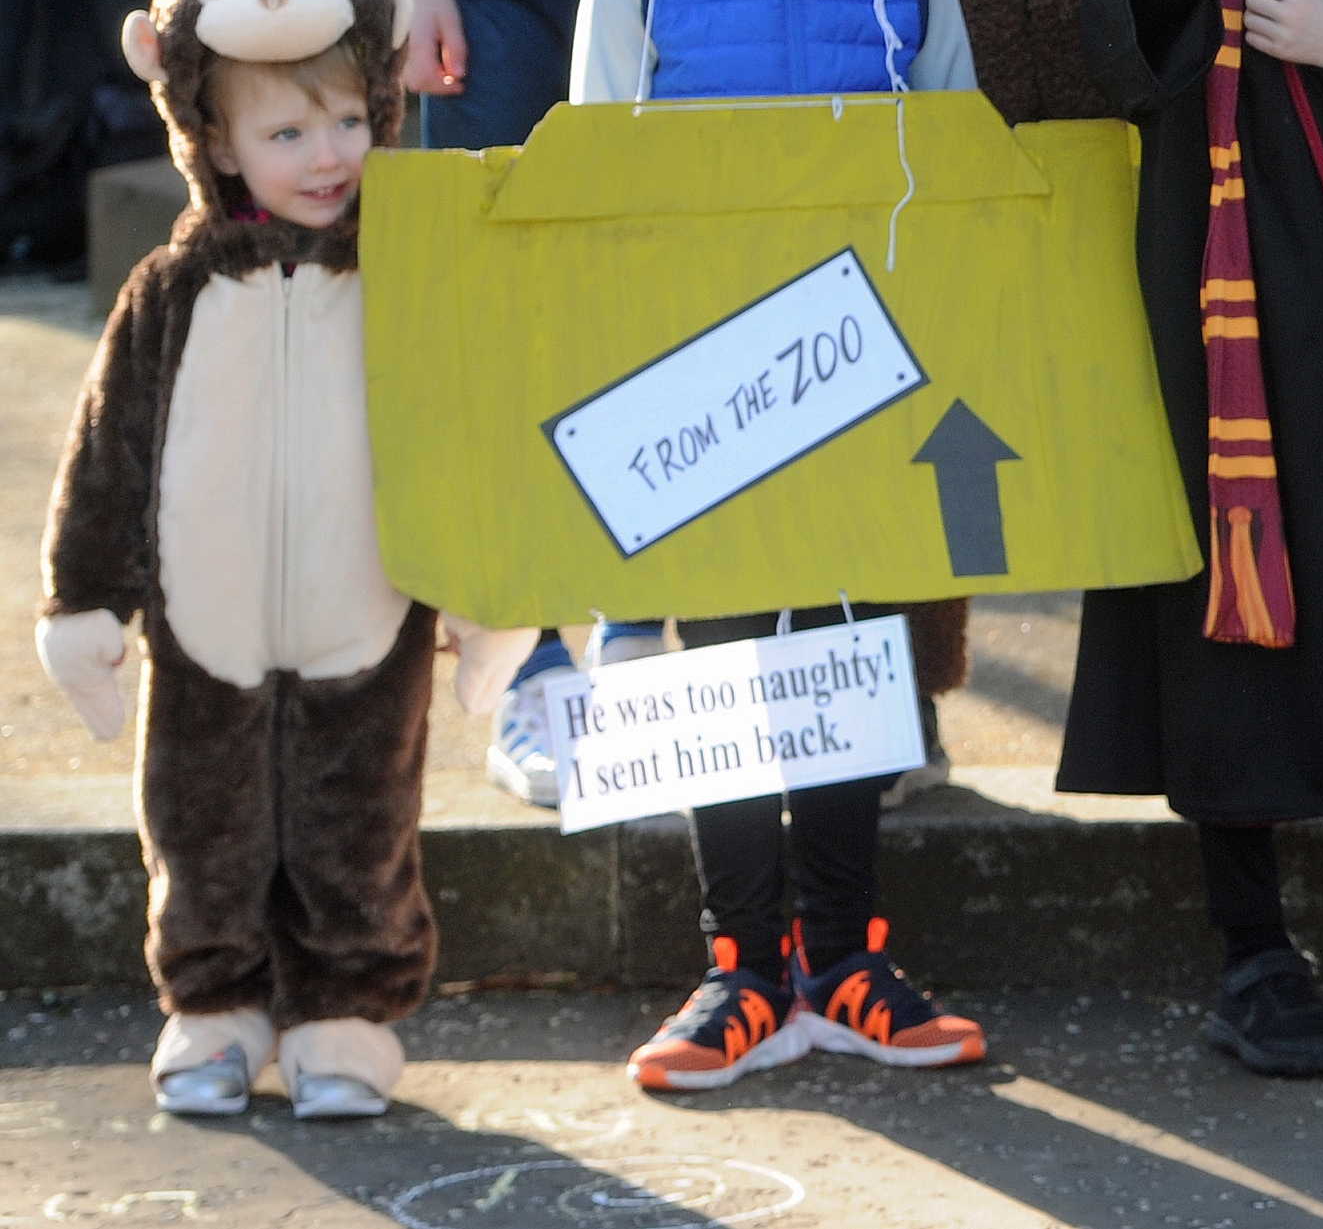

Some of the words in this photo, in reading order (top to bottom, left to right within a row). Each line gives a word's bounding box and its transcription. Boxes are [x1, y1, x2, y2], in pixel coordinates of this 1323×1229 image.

[628, 412, 720, 492] FROM
[725, 369, 778, 432] THE
[775, 314, 863, 406] ZOO
[563, 691, 605, 739] He
[616, 688, 676, 727] was
[686, 680, 737, 715] too
[749, 639, 896, 707] naughty!
[571, 757, 585, 799] I
[596, 742, 664, 796] sent
[673, 735, 743, 779] him
[754, 712, 853, 765] back.
